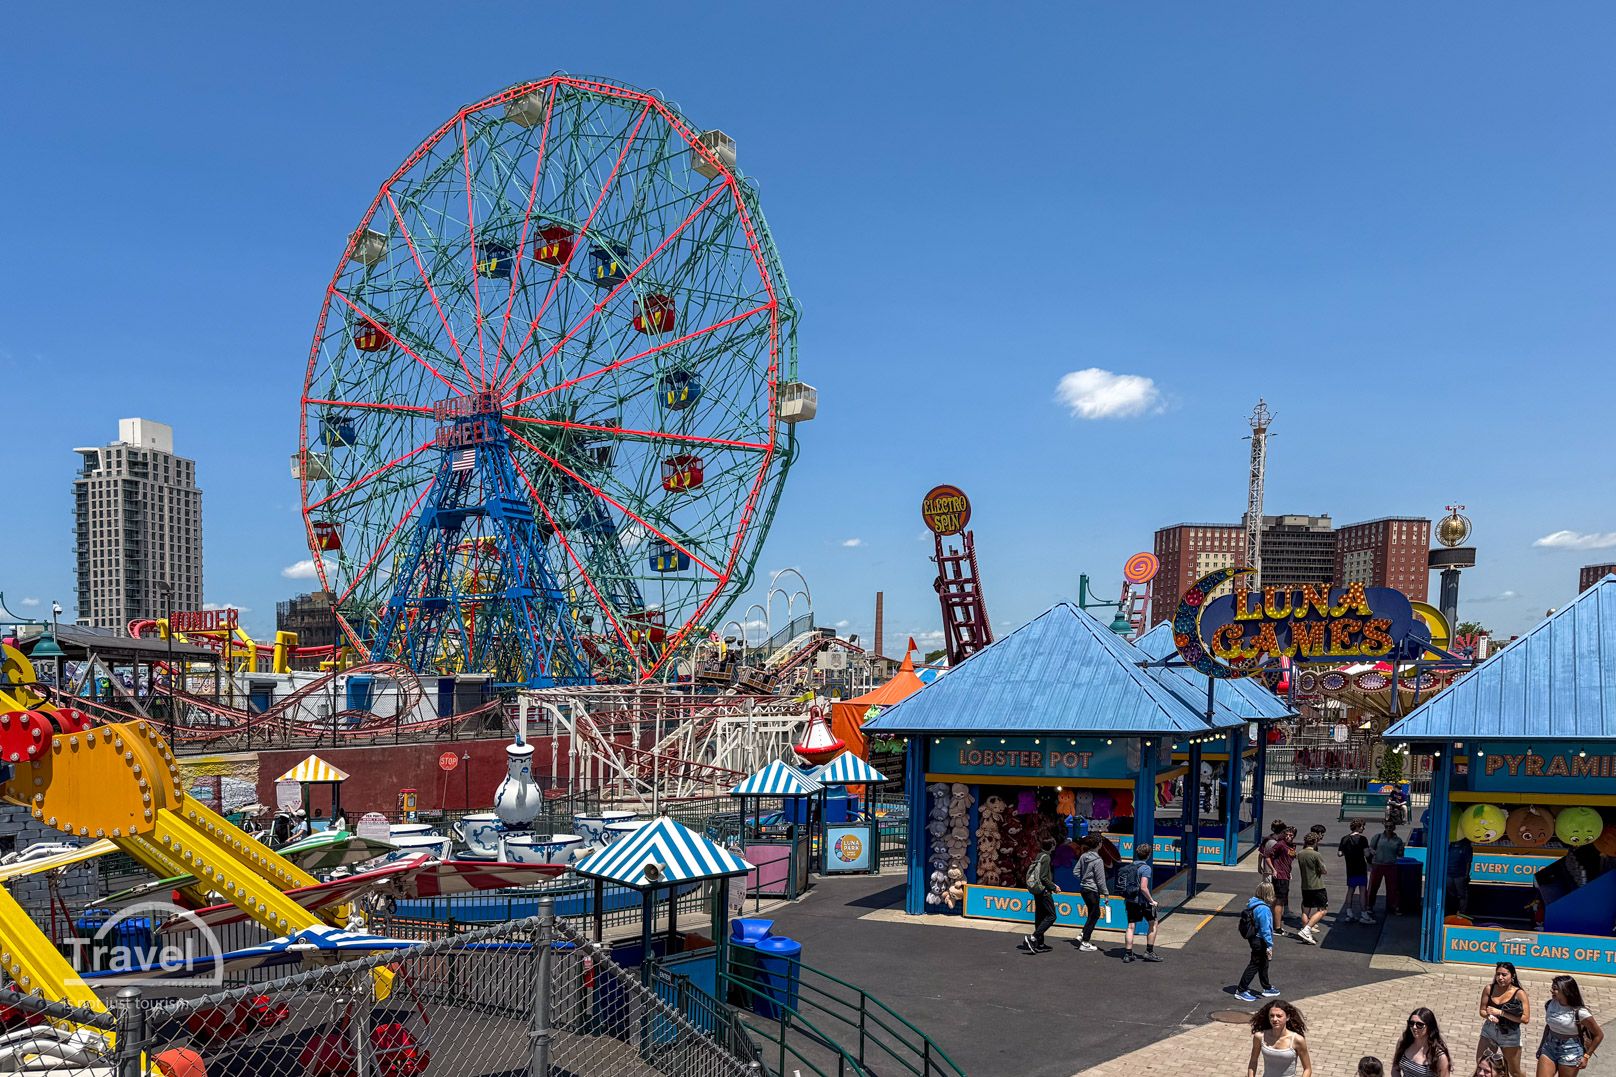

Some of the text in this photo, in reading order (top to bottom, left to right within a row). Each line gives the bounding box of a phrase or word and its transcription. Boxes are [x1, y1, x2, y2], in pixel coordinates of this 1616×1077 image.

[433, 391, 502, 422] WONDER
[435, 421, 495, 448] WHEEL
[923, 495, 967, 515] ELECTRO
[935, 513, 960, 532] SPIN
[1233, 581, 1373, 621] LUNA
[1212, 618, 1394, 660] GAMES
[959, 749, 1093, 769] LOBSTER POT
[1474, 862, 1510, 874] EVERY
[983, 895, 1022, 912] TWO
[1451, 938, 1497, 953] KNOCK
[1501, 943, 1527, 956] THE
[1530, 945, 1570, 960] CANS
[1574, 949, 1601, 962] OFF
